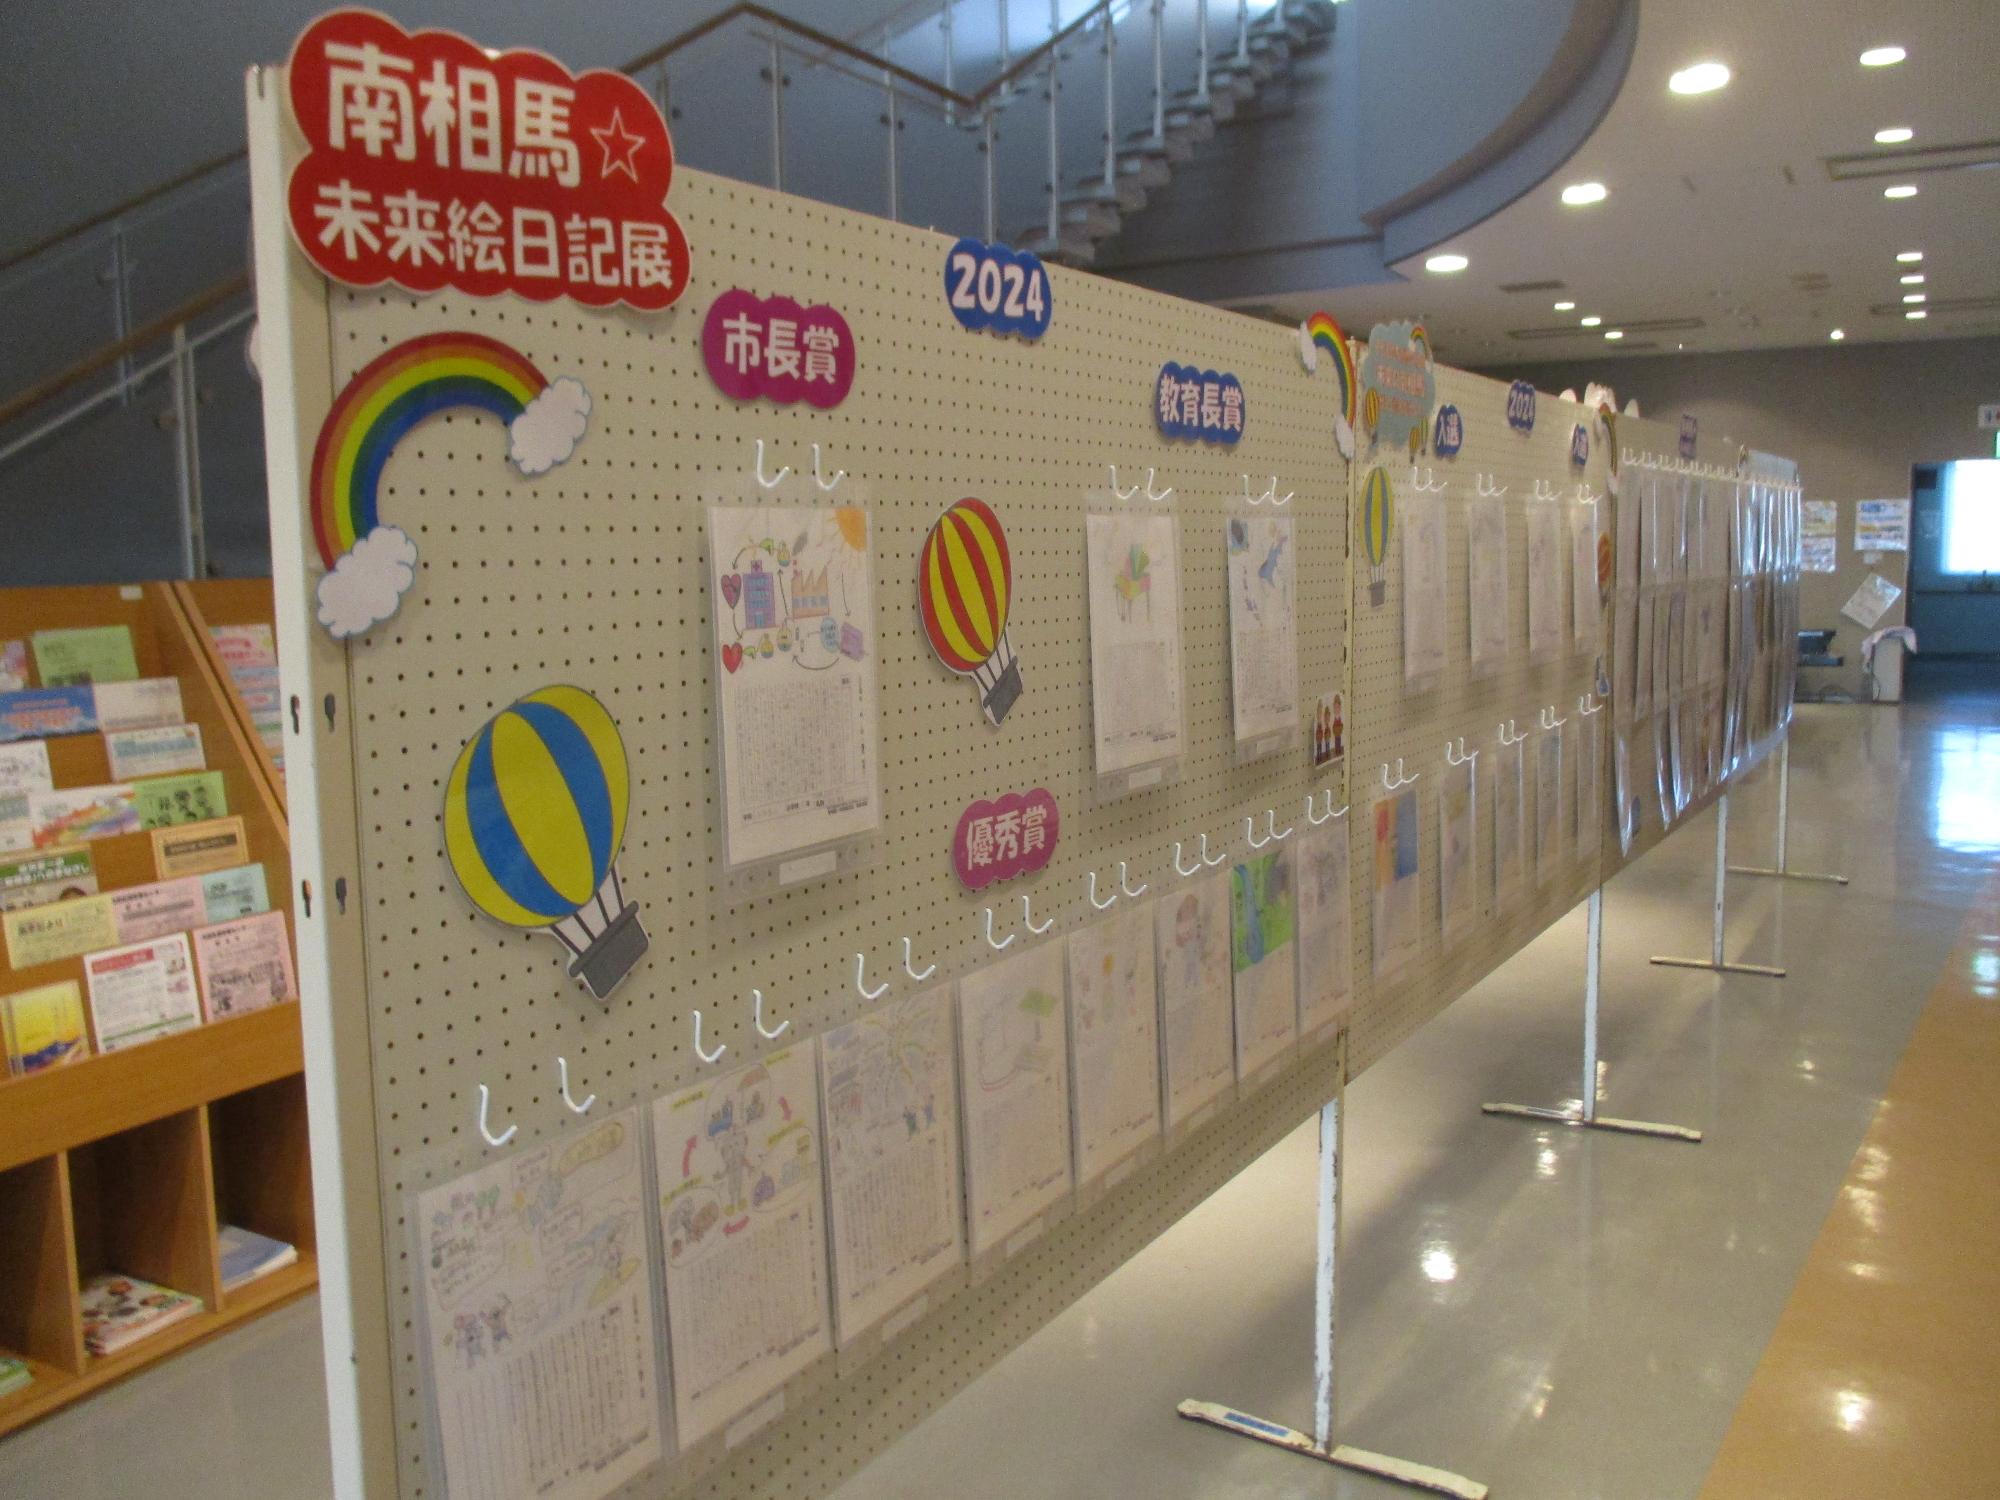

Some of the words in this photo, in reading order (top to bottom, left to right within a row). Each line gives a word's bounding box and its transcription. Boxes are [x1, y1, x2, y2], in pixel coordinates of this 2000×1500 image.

[324, 42, 581, 188] 南相馬
[313, 179, 673, 289] 未来絵日記展
[951, 253, 1044, 322] 2024
[722, 312, 840, 384] 市長賞
[1159, 374, 1243, 432] 教育長賞
[966, 804, 1048, 871] 優秀賞
